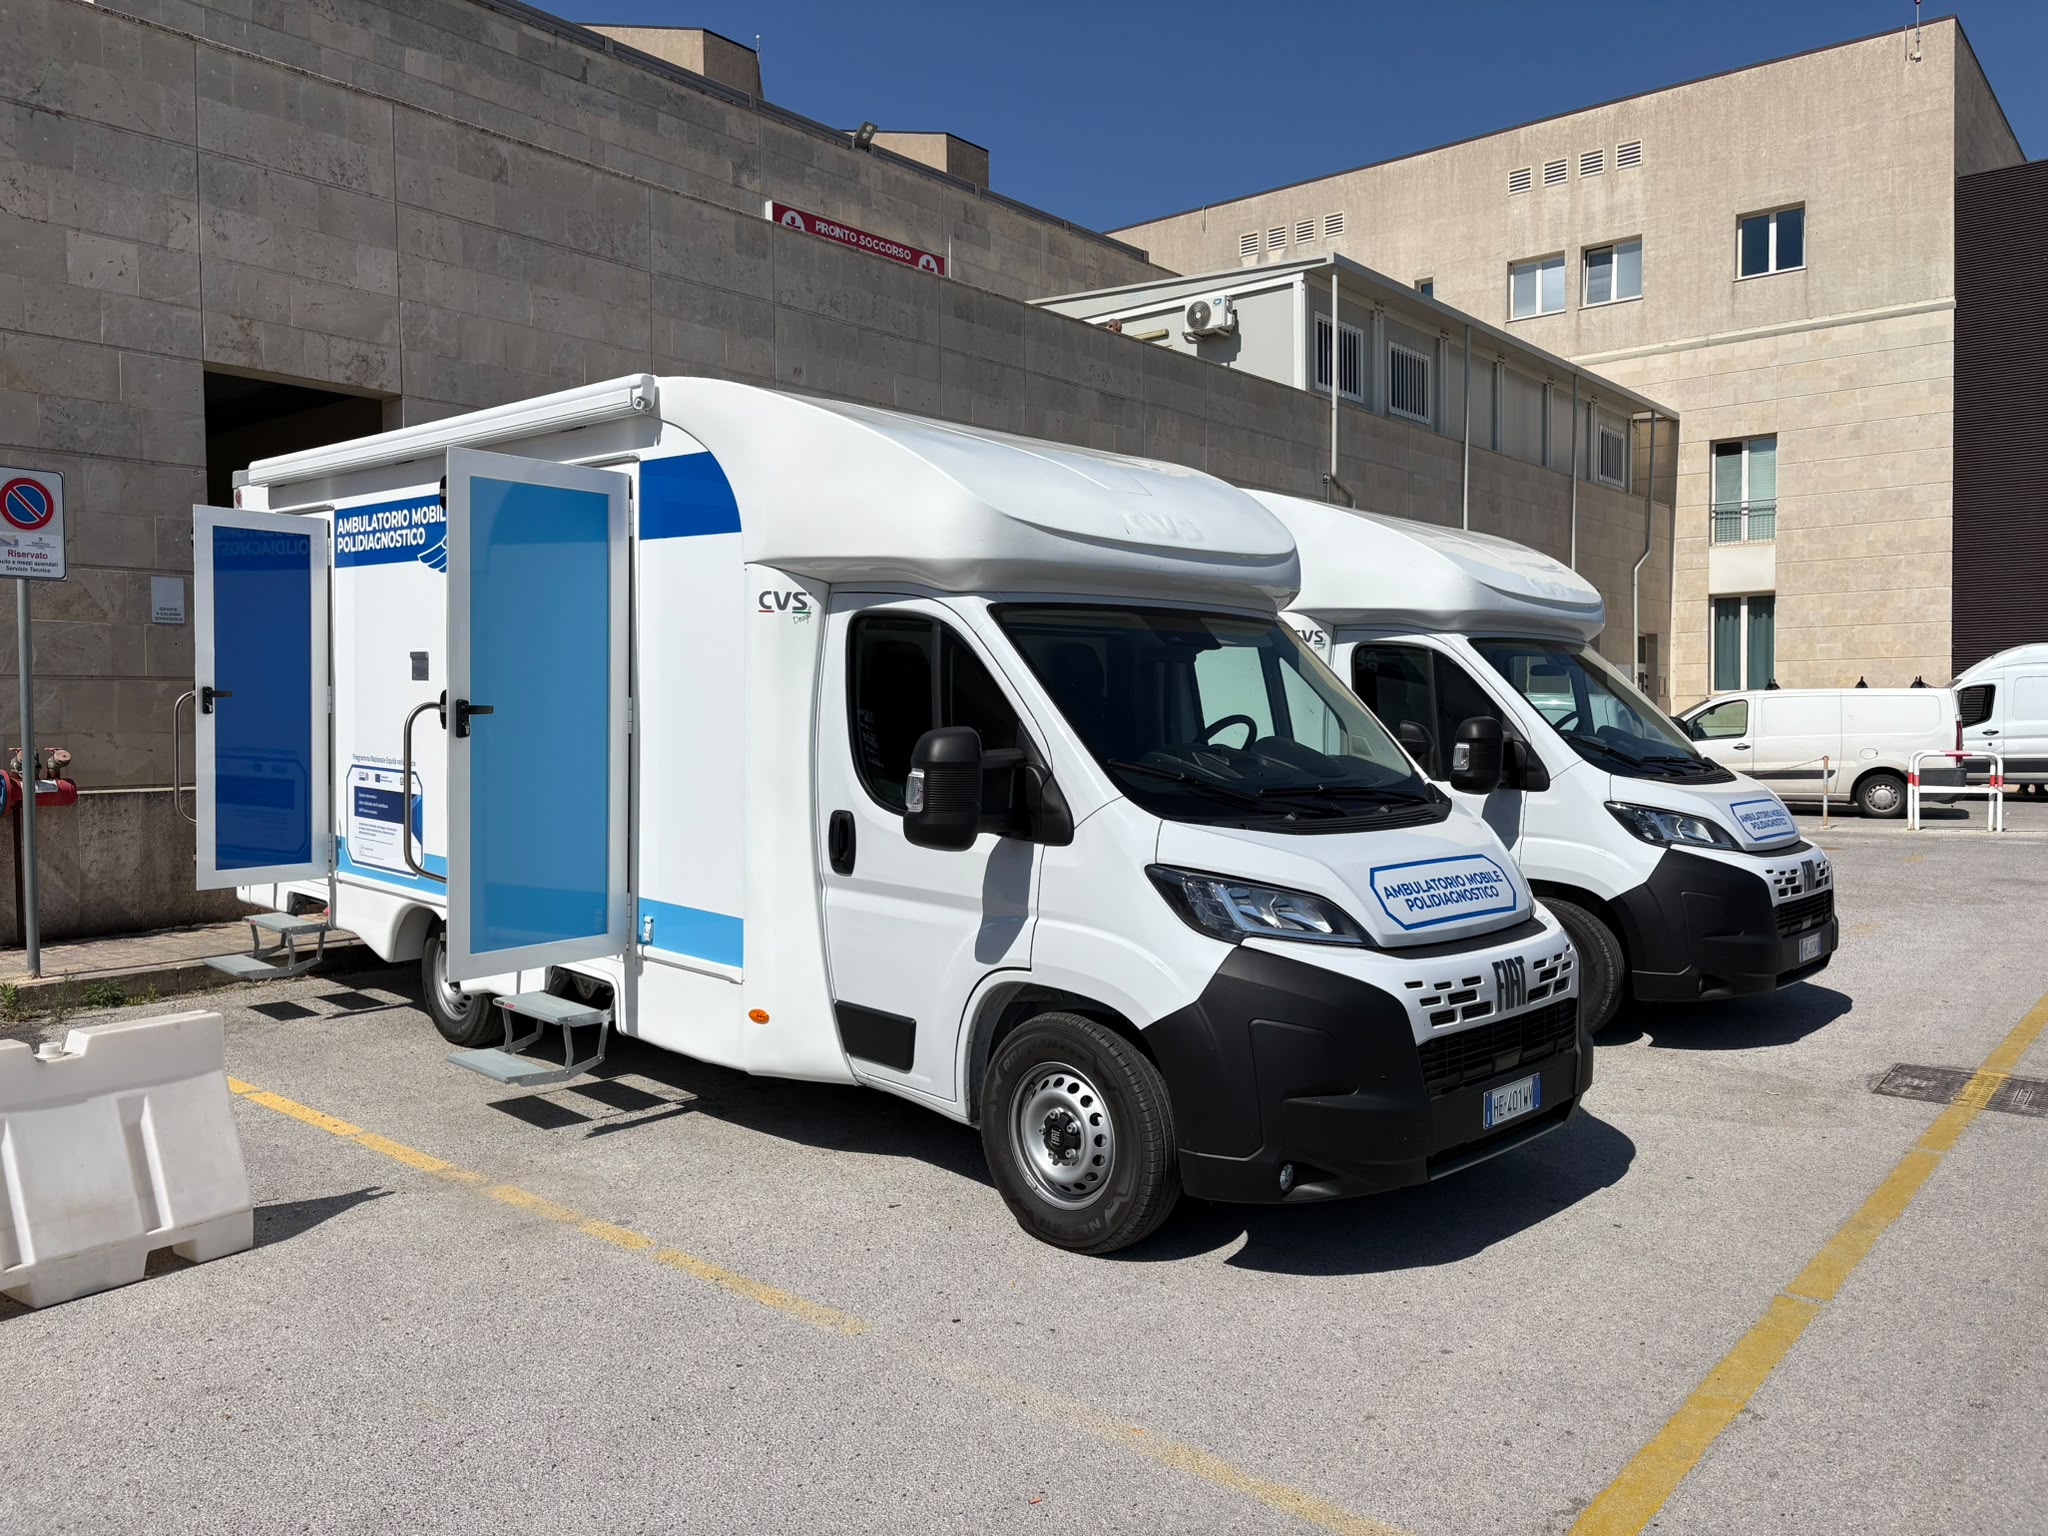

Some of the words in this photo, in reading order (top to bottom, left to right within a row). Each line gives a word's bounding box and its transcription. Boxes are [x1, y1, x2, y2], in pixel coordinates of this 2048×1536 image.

[815, 220, 858, 243] PRONTO
[859, 235, 912, 260] SOCCORSO
[337, 509, 410, 535] AMBULATORIO
[337, 527, 426, 553] POLIDIAGNOSTICO
[7, 549, 49, 560] Riservato
[758, 590, 808, 611] CVS
[1383, 874, 1466, 900] AMBULATORIO
[1463, 870, 1503, 886] MOBILE
[1404, 885, 1500, 912] POLIDIAGNOSTICO
[1491, 955, 1527, 1012] FIAT
